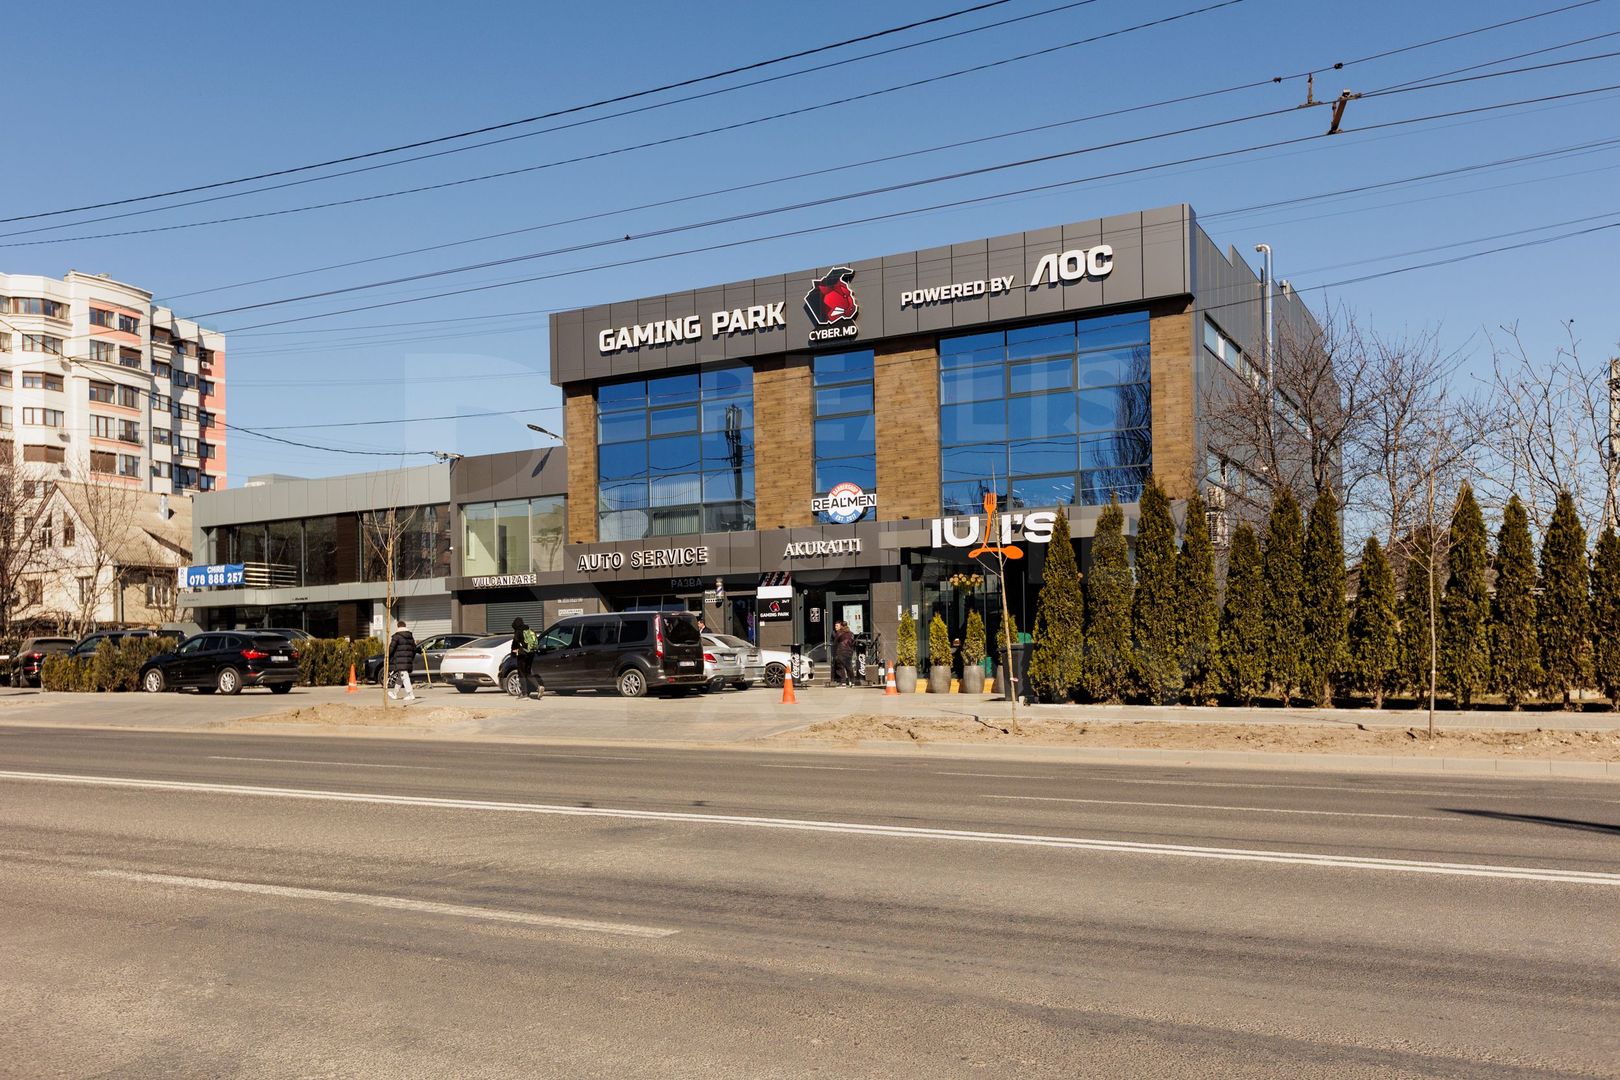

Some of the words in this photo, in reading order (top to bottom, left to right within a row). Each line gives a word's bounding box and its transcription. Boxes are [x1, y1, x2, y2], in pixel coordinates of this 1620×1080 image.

[1029, 244, 1113, 286] AOC
[901, 279, 986, 306] POWERED
[990, 274, 1015, 292] BY
[599, 315, 702, 352] GAMING
[711, 301, 786, 335] PARK
[808, 324, 858, 341] CYBER.MD
[784, 538, 862, 556] AKURATTI
[577, 552, 624, 572] AUTO
[630, 546, 709, 568] SERVICE
[227, 571, 243, 584] 257
[472, 574, 537, 587] VULCANIZARE
